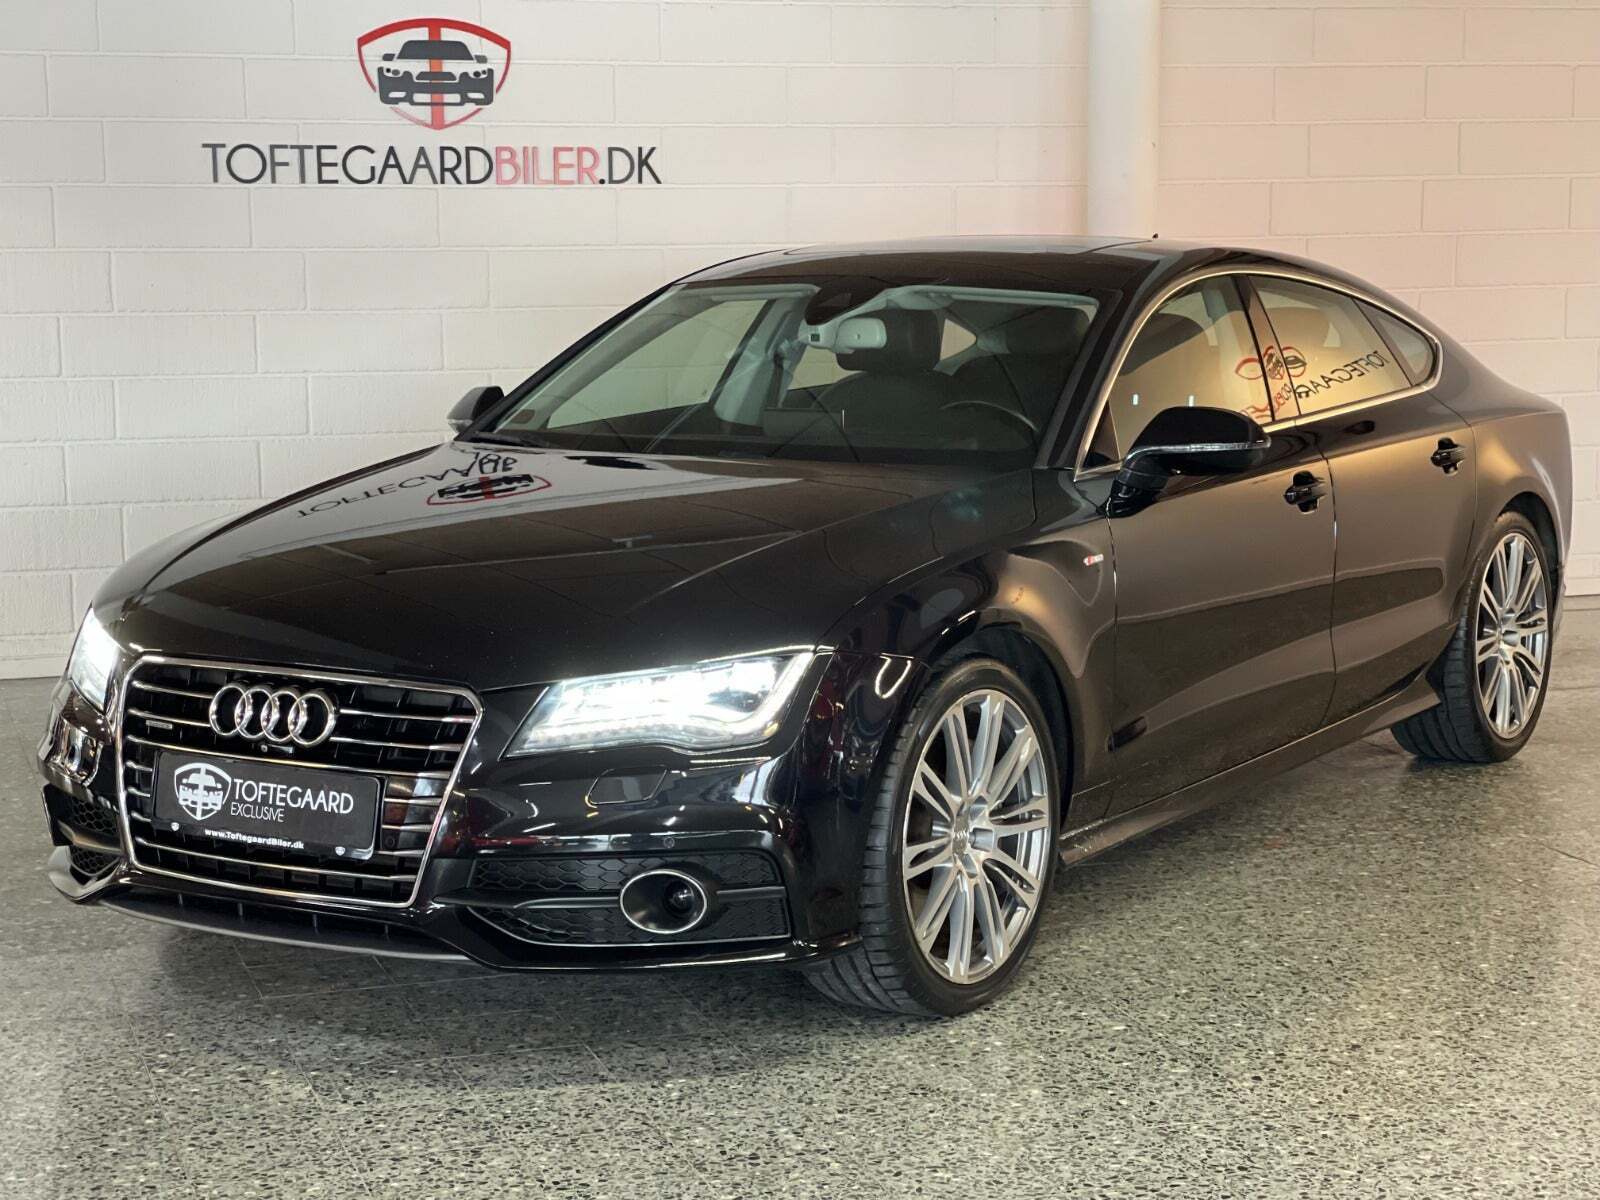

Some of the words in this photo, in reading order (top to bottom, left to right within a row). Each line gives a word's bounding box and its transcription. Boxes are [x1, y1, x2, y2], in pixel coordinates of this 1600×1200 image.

[201, 143, 662, 185] TOFTEGAARDBILER.DK
[230, 802, 285, 823] EXCLUSIVE
[233, 778, 354, 815] TOFTEGAARD
